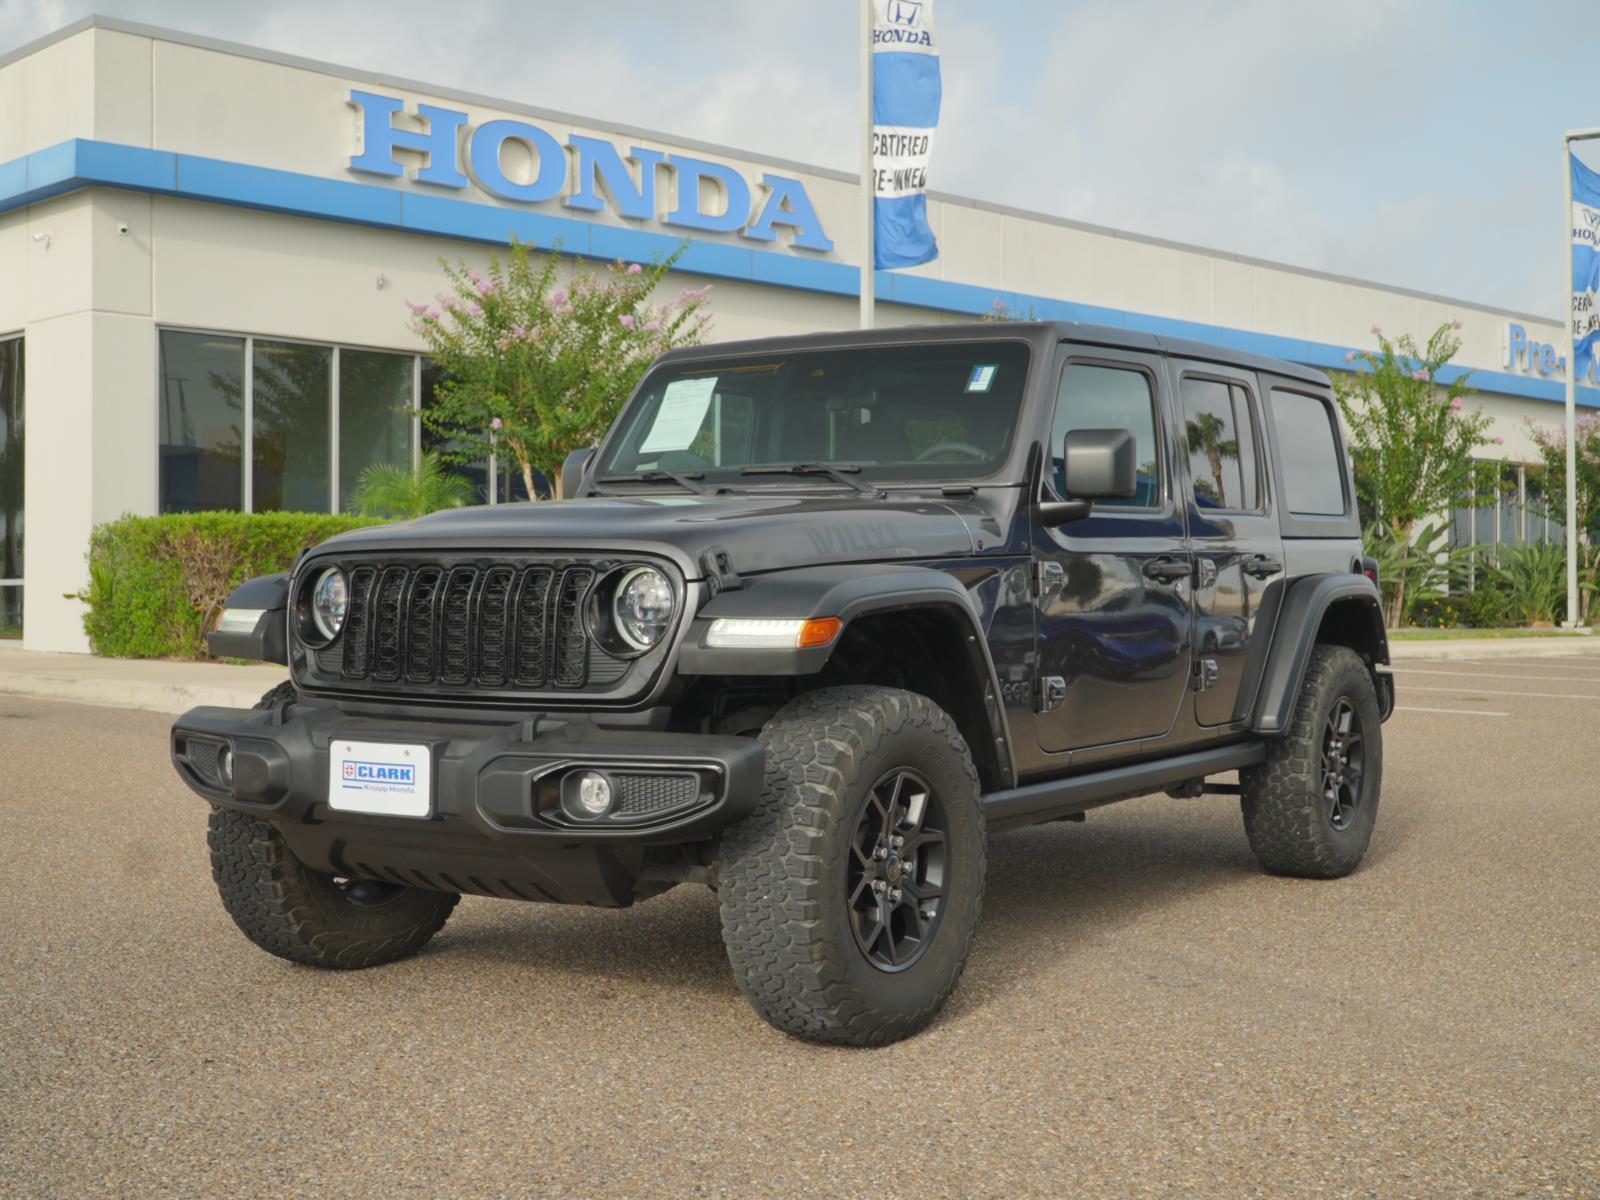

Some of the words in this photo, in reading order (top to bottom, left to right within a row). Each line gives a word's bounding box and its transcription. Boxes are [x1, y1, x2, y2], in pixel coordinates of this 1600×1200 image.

[873, 29, 933, 47] HONDA
[348, 88, 834, 253] HONDA
[358, 766, 411, 780] CLARK
[389, 785, 416, 794] Honda
